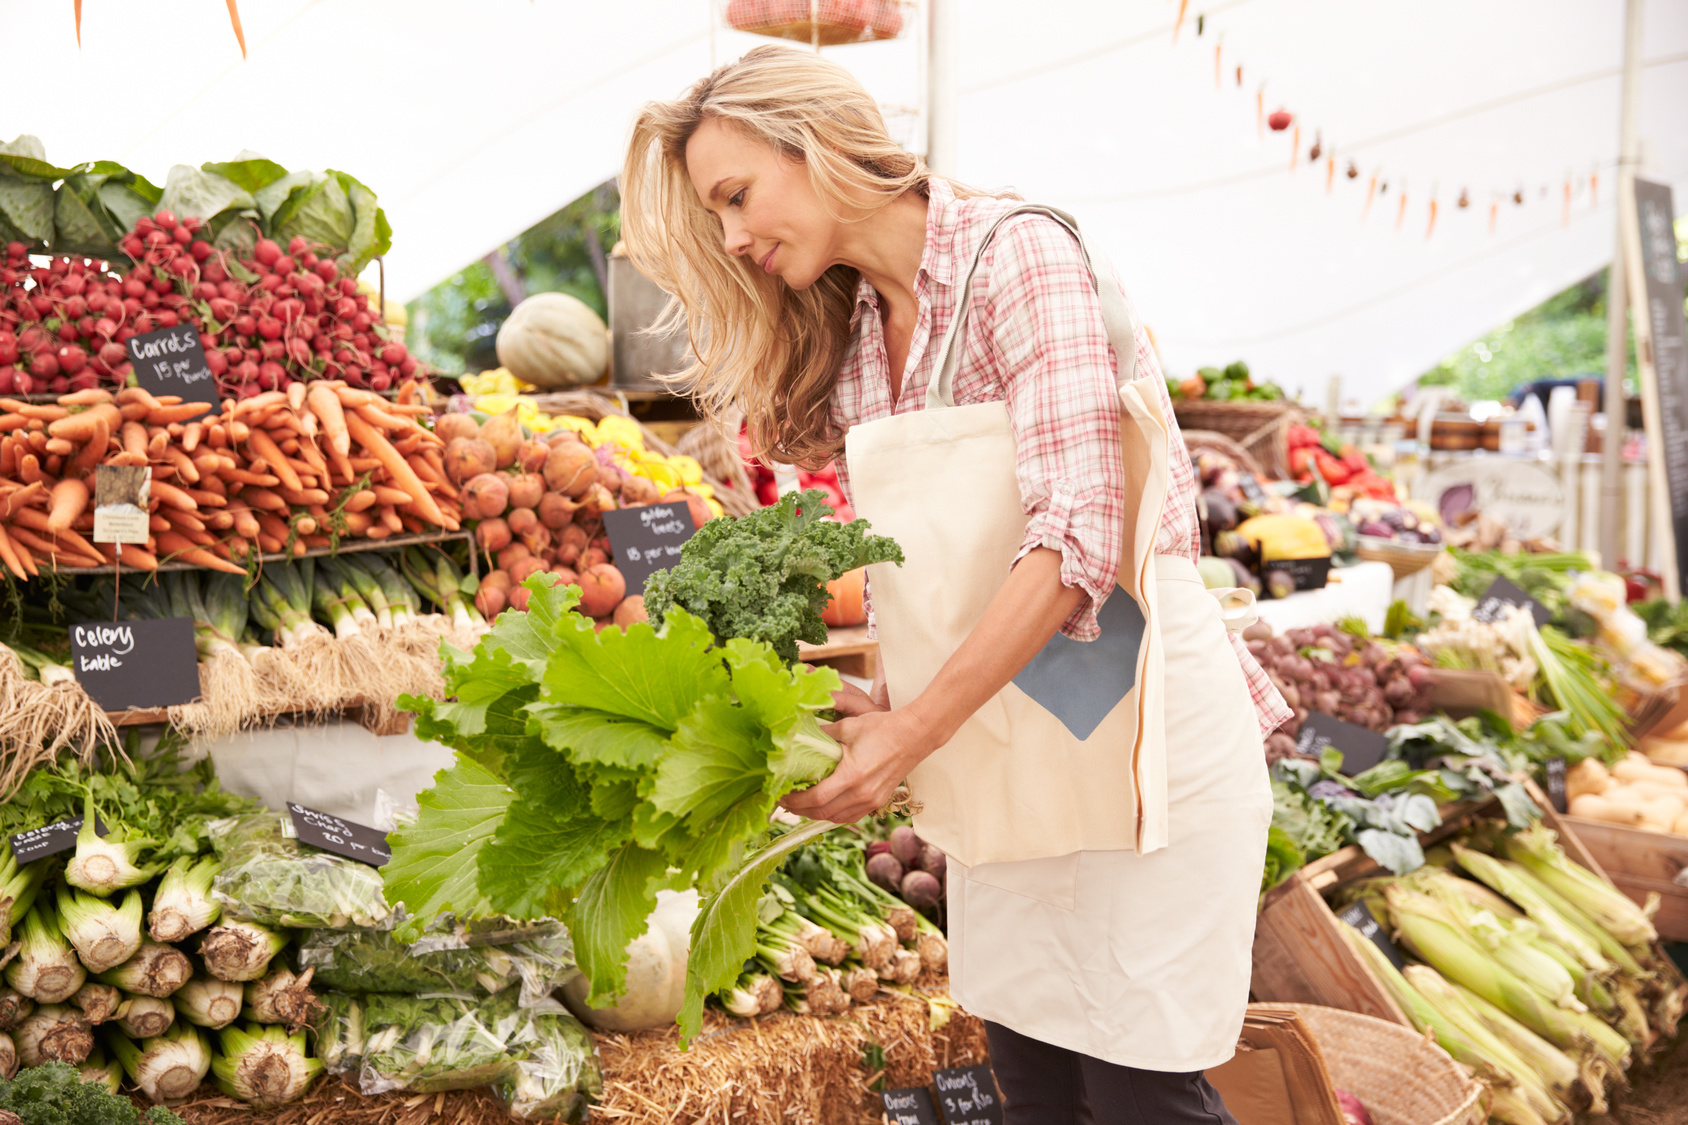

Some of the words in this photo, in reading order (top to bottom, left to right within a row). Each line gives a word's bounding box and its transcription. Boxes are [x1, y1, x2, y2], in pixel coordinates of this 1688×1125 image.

[131, 331, 197, 360] Carrots
[152, 360, 173, 381] 15
[172, 358, 190, 378] per
[75, 625, 135, 656] Celery
[80, 653, 123, 673] table
[303, 816, 353, 837] Chard
[322, 832, 345, 845] 20
[936, 1070, 977, 1092] Onions
[883, 1092, 919, 1110] Onions
[945, 1096, 957, 1113] 3
[957, 1097, 974, 1116] for
